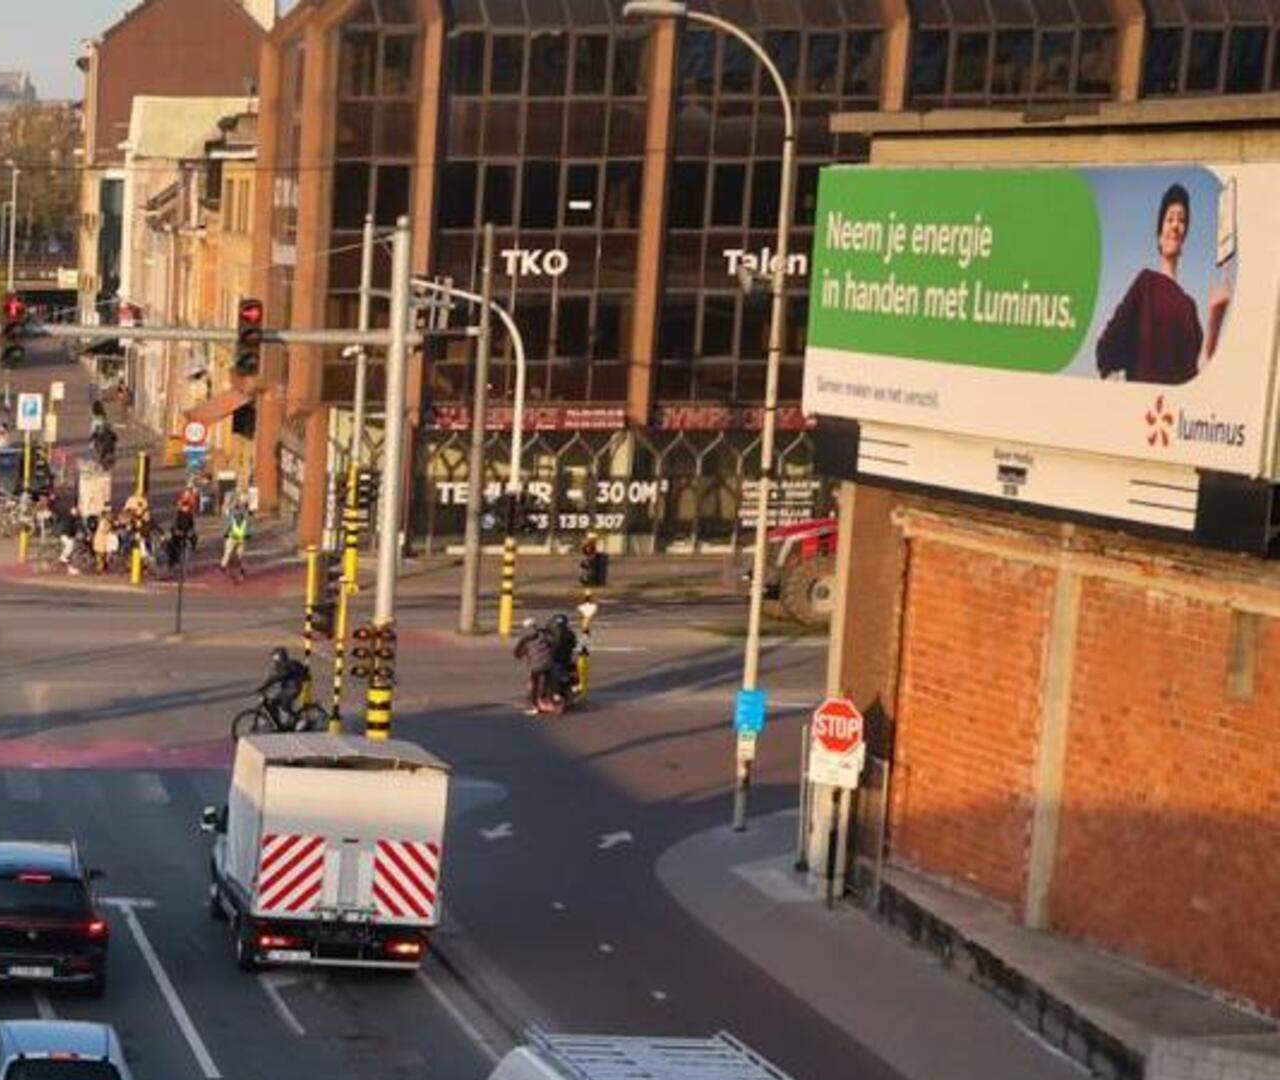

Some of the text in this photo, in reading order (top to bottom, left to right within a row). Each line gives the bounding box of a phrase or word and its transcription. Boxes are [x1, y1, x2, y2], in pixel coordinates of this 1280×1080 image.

[826, 211, 993, 268] Neem je energie
[501, 249, 569, 276] TKO
[822, 269, 1077, 328] in handen met Luminus.
[1177, 409, 1246, 447] luminus
[436, 481, 470, 504] TE
[817, 714, 859, 740] STOP
